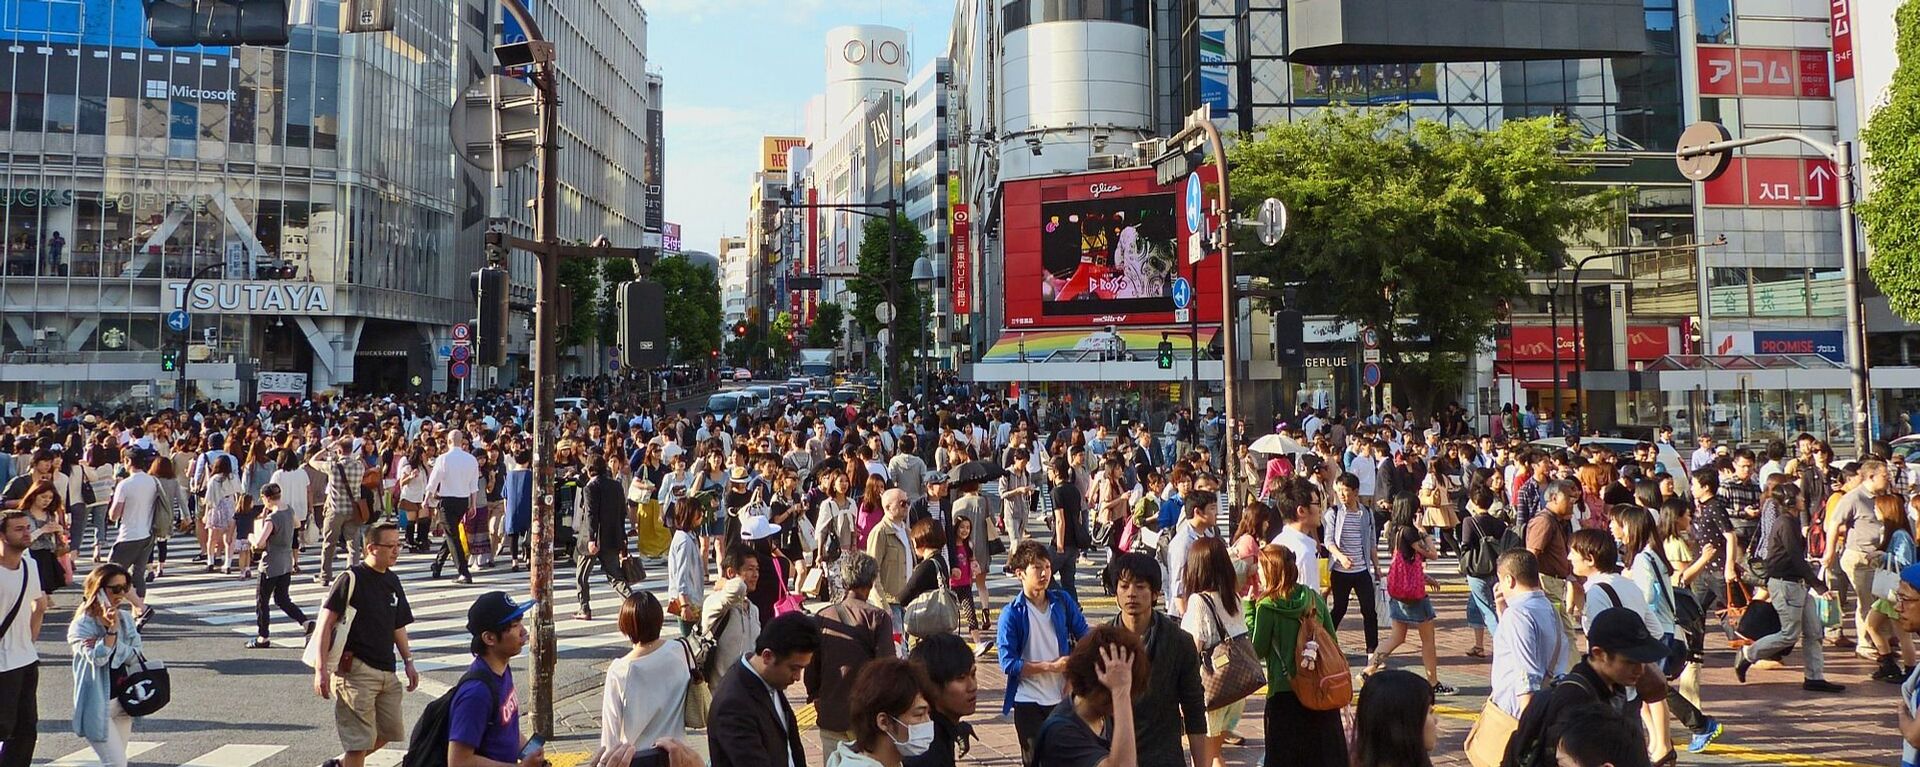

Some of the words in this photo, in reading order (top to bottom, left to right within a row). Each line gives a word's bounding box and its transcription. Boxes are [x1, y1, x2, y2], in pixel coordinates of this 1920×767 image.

[1709, 60, 1791, 84] アコム
[171, 85, 237, 101] Microsoft
[870, 110, 889, 148] ZAR
[1090, 184, 1121, 198] Glico
[1759, 184, 1789, 200] 入口
[169, 283, 329, 311] TSUTAYA
[1761, 341, 1814, 353] PROMISE
